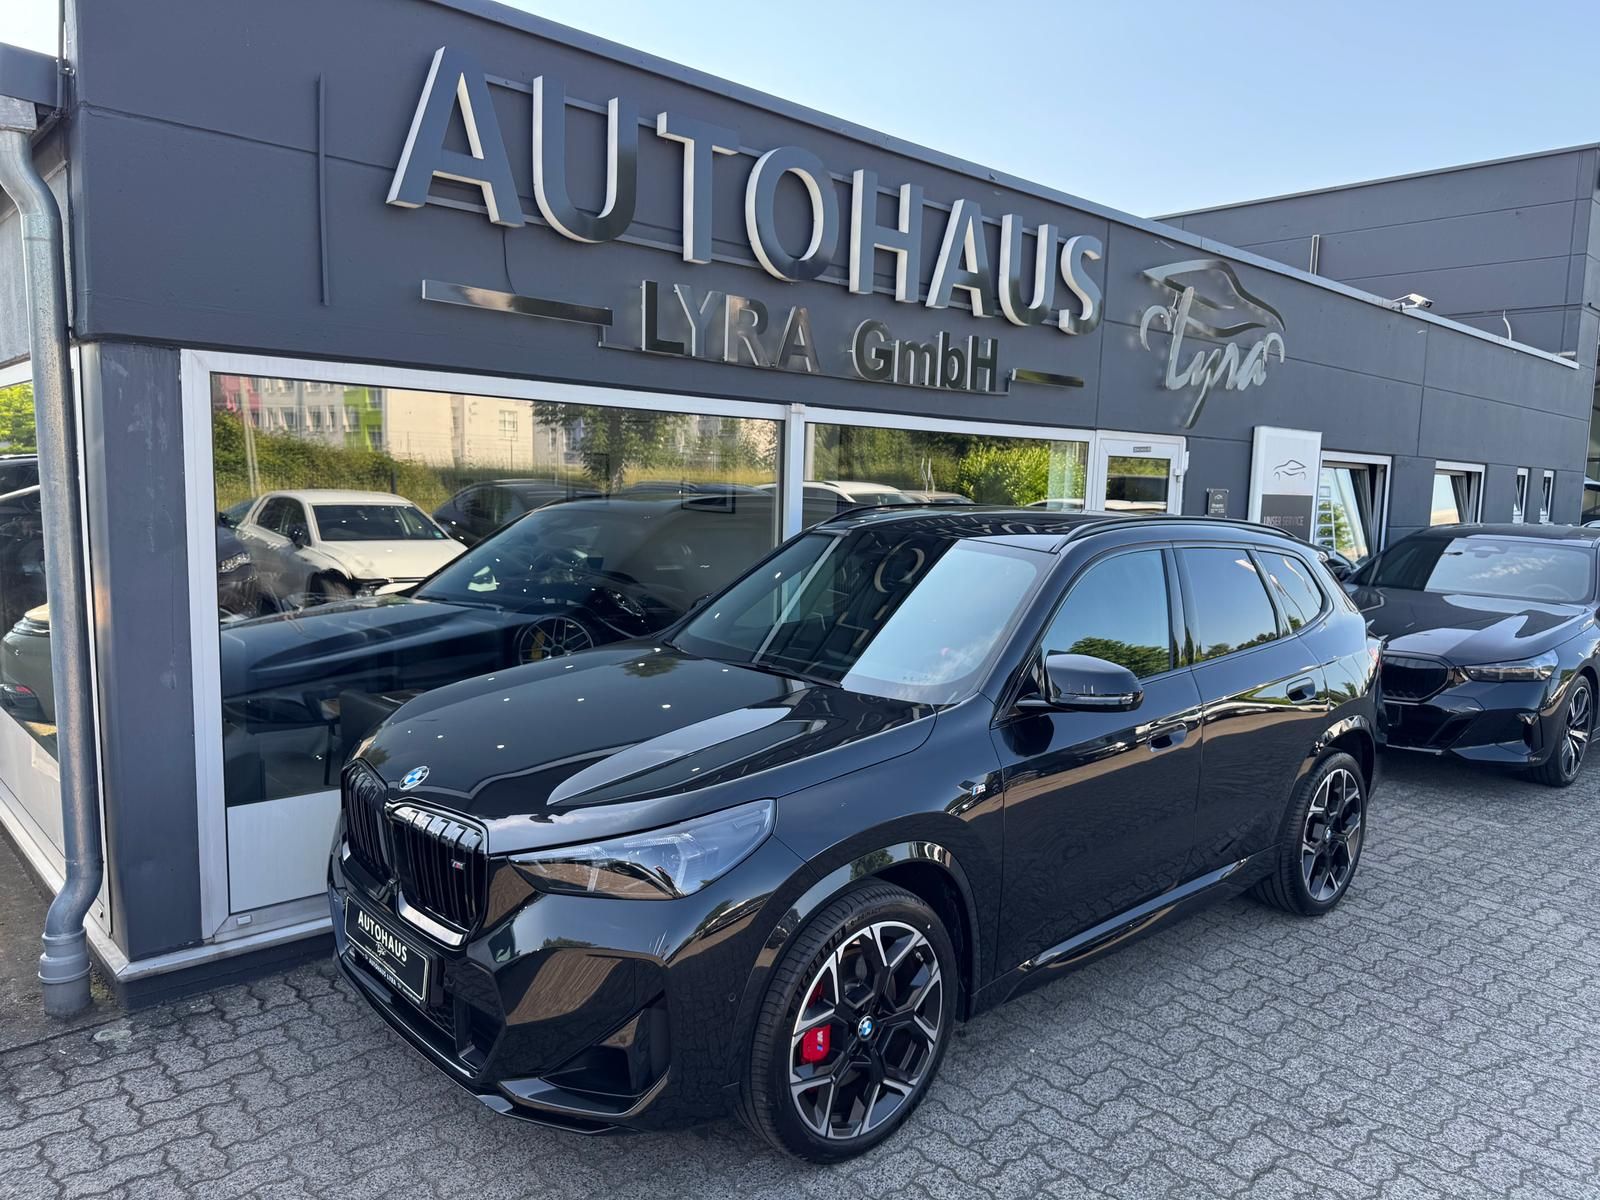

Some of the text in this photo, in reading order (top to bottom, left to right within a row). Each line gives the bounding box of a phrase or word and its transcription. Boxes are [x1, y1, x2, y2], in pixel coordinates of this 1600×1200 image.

[386, 45, 1104, 336] AUTOHAUS
[640, 279, 1000, 394] LYRA GmbH
[357, 910, 408, 963] AUTOHAUS
